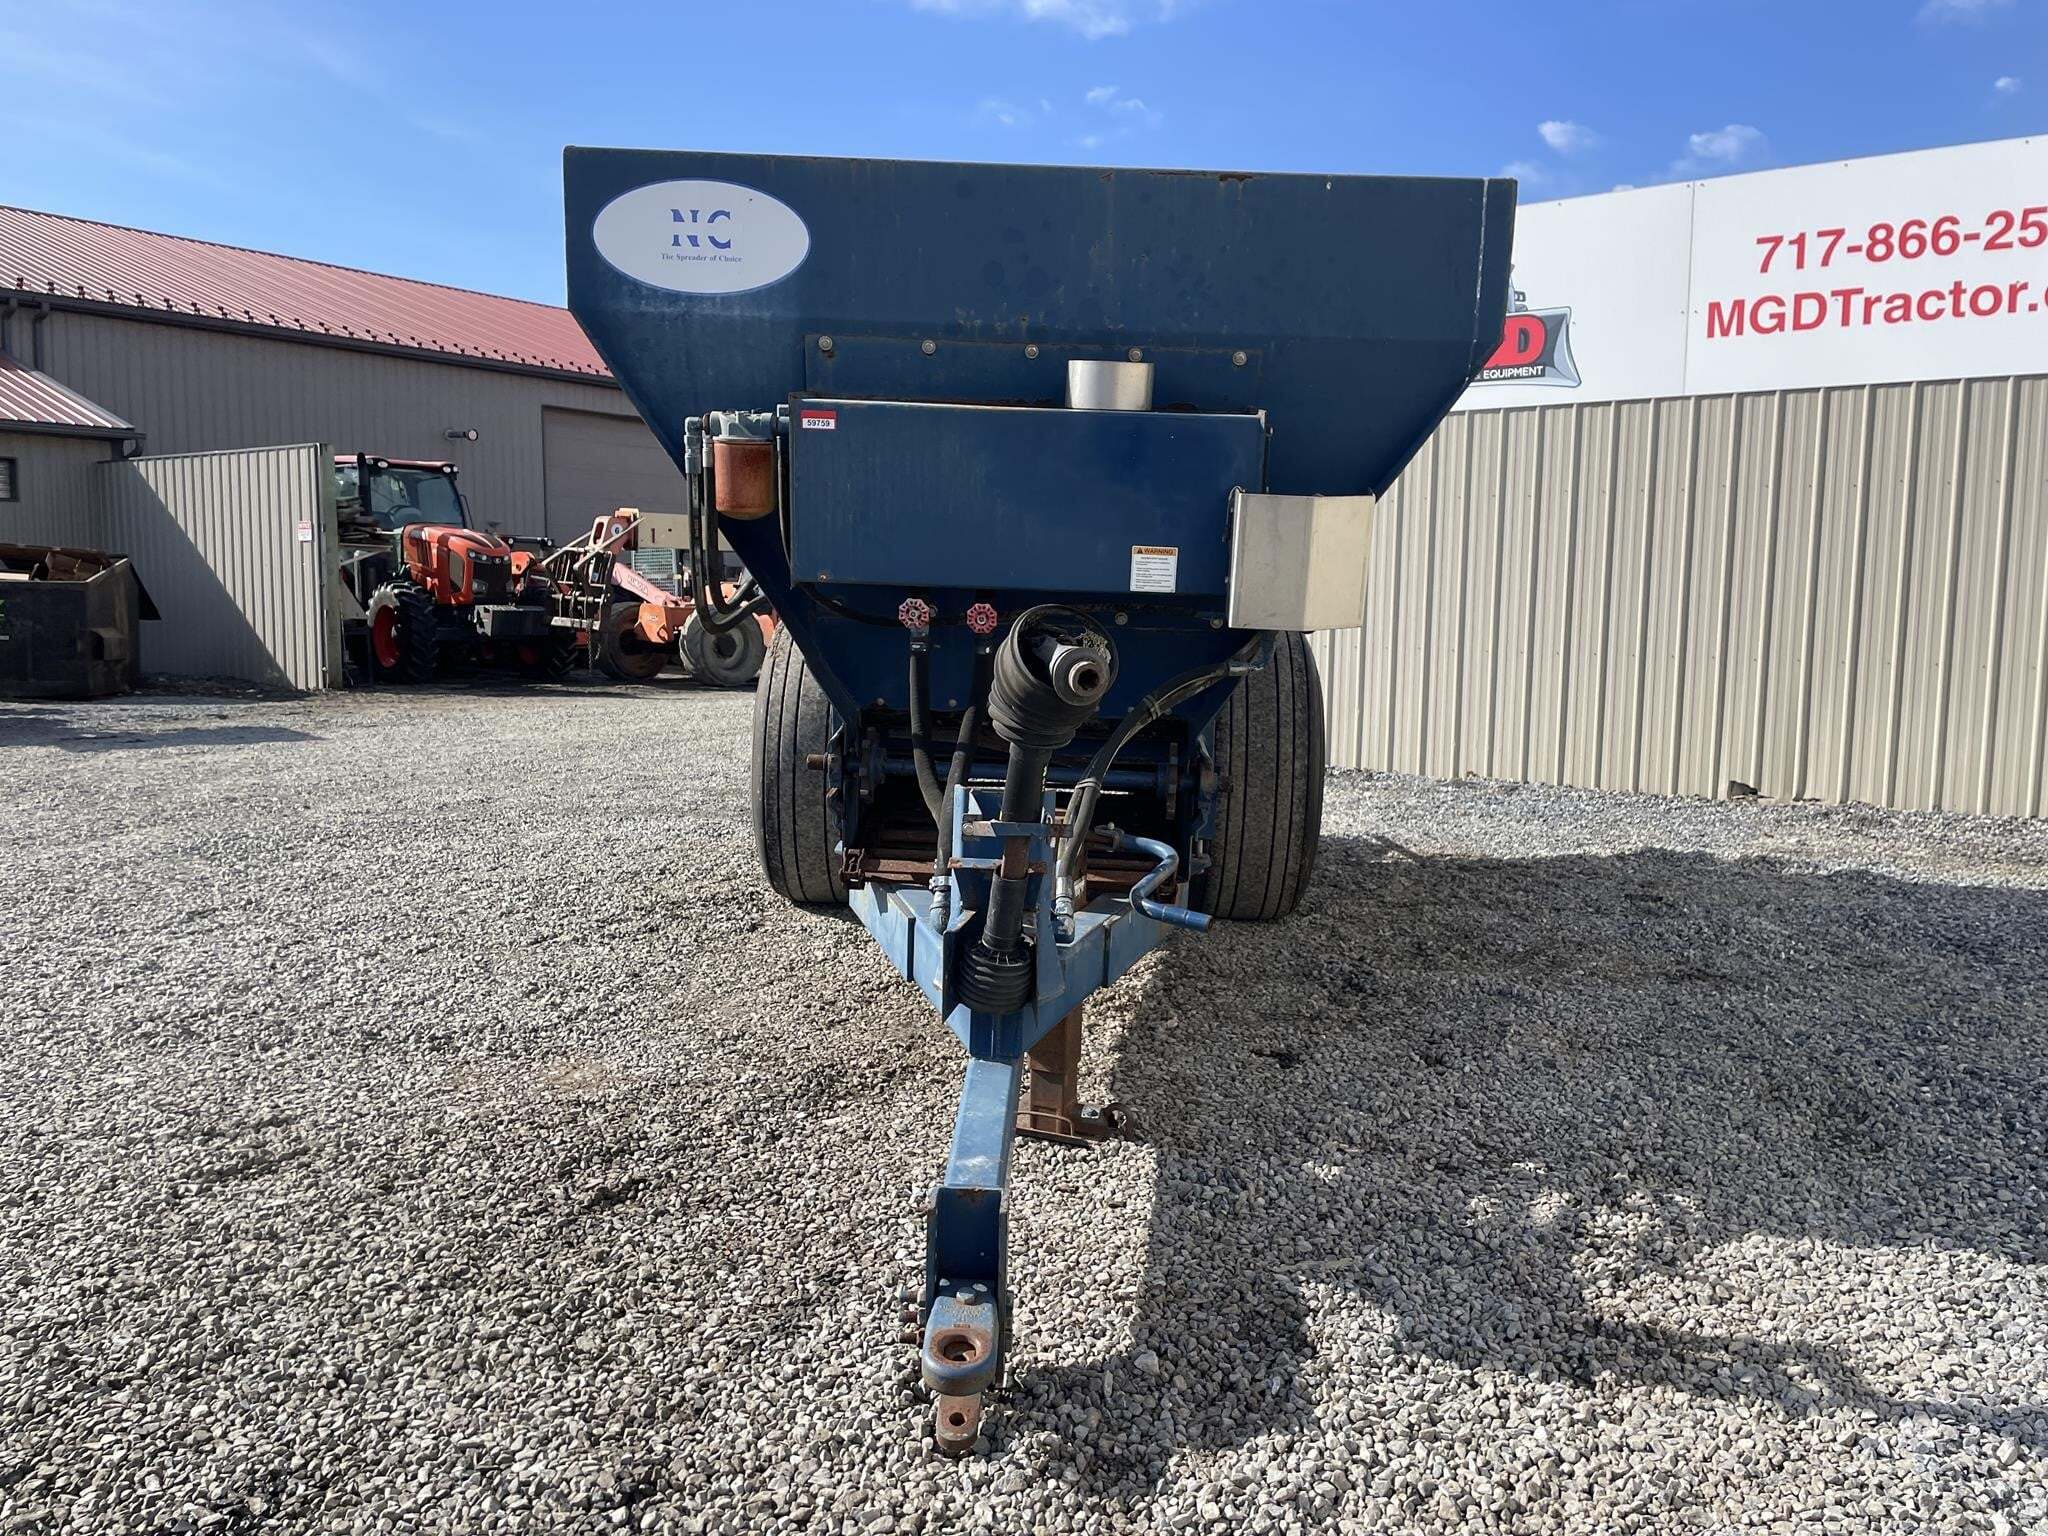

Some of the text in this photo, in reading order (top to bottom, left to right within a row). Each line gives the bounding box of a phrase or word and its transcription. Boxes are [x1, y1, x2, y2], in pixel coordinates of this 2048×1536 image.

[670, 208, 732, 249] NC
[1756, 206, 2048, 273] 717-866-25
[661, 253, 674, 261] The
[676, 253, 707, 262] Spreader
[718, 255, 743, 263] Choice
[1707, 281, 2048, 338] MGDTractor.
[1483, 365, 1544, 379] EQUIPMENT
[1143, 547, 1174, 556] WARNING
